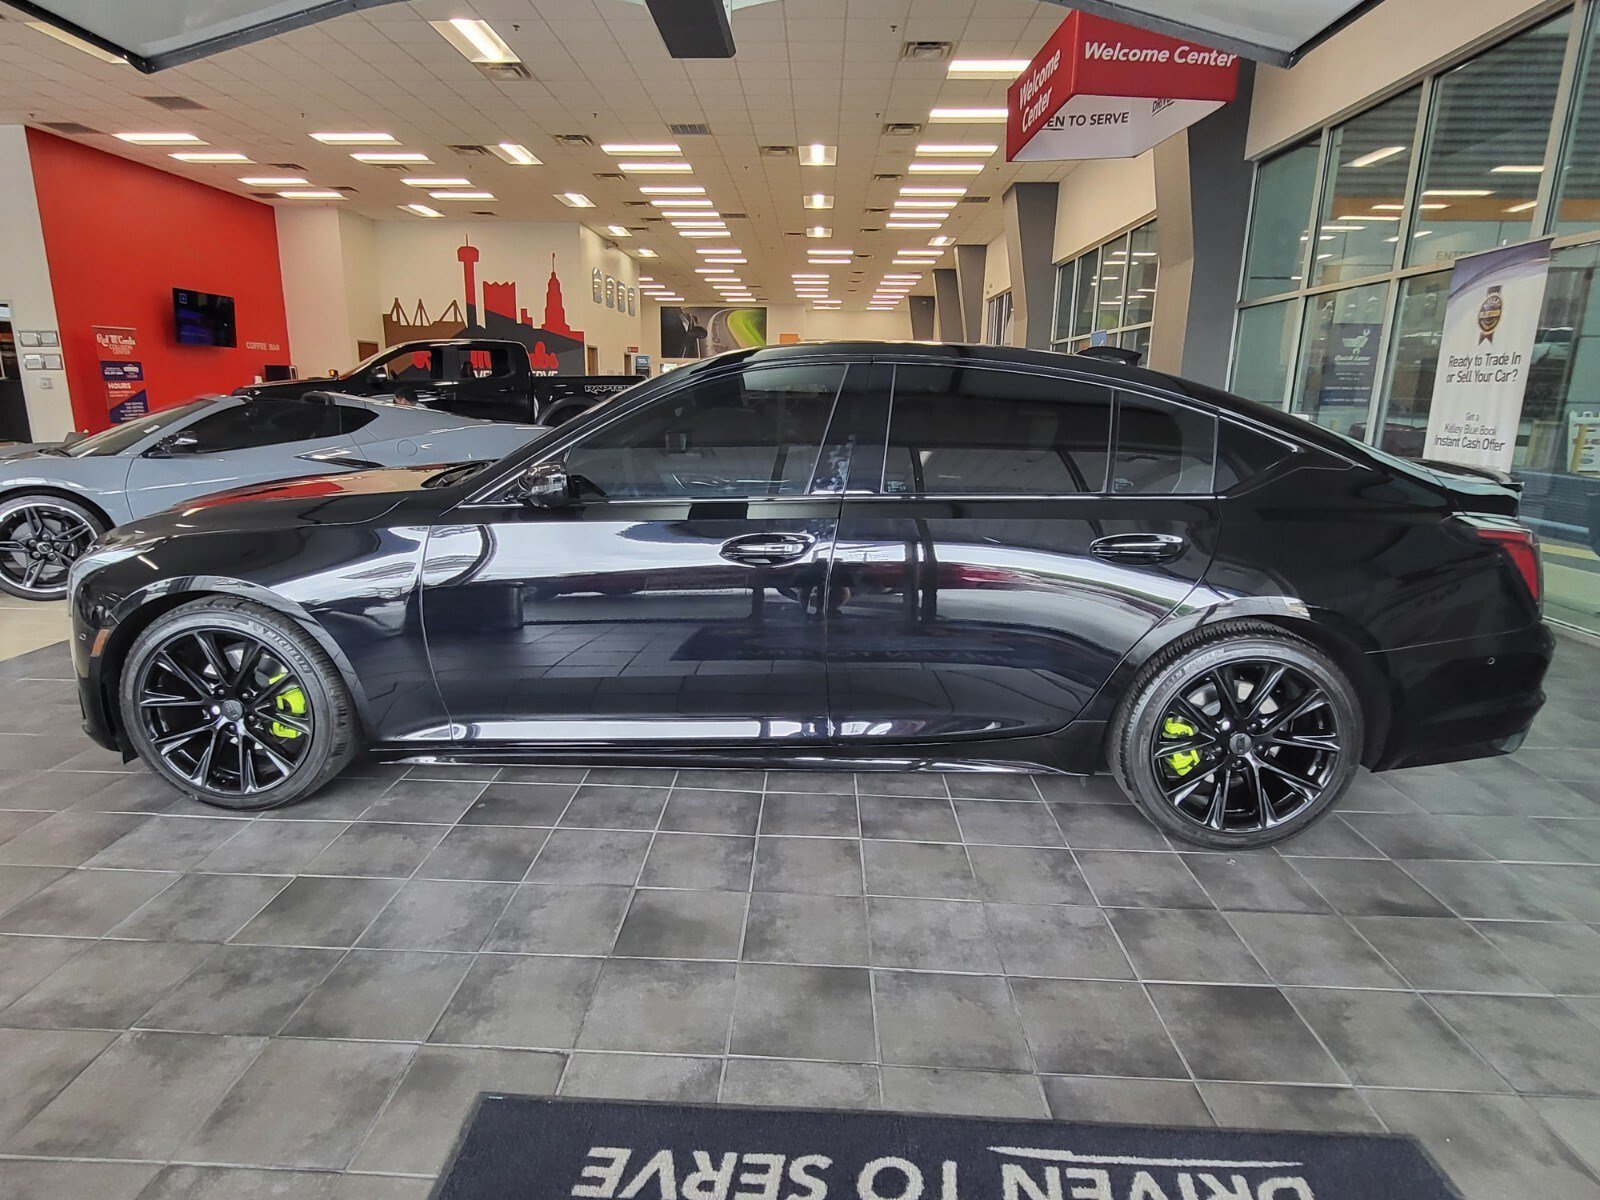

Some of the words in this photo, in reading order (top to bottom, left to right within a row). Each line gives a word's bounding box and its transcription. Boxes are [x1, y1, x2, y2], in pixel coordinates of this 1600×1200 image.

[1085, 41, 1170, 63] Welcome
[1174, 45, 1237, 67] Center
[1019, 48, 1061, 111] Welcome
[1022, 86, 1053, 133] Center
[1047, 115, 1066, 128] EN
[1069, 114, 1087, 127] TO
[1090, 112, 1129, 126] SERVE
[246, 341, 268, 351] COFFEE
[268, 343, 280, 351] BAR
[1448, 355, 1473, 369] Ready
[1474, 355, 1482, 366] to
[1486, 352, 1509, 366] Trade
[1511, 351, 1521, 365] In
[1446, 373, 1455, 383] or
[1456, 370, 1472, 383] Sell
[1474, 370, 1493, 382] Your
[1495, 368, 1518, 382] Car?
[584, 384, 630, 395] RAPTO
[1465, 411, 1475, 421] Get
[1444, 423, 1463, 436] Kelley
[1463, 424, 1478, 435] Blue
[1480, 425, 1497, 436] Book
[1434, 434, 1460, 447] Instant
[1461, 436, 1480, 449] Cash
[1482, 438, 1506, 452] Offer
[265, 630, 312, 672] MICHELIN
[571, 1147, 833, 1200] SERVE
